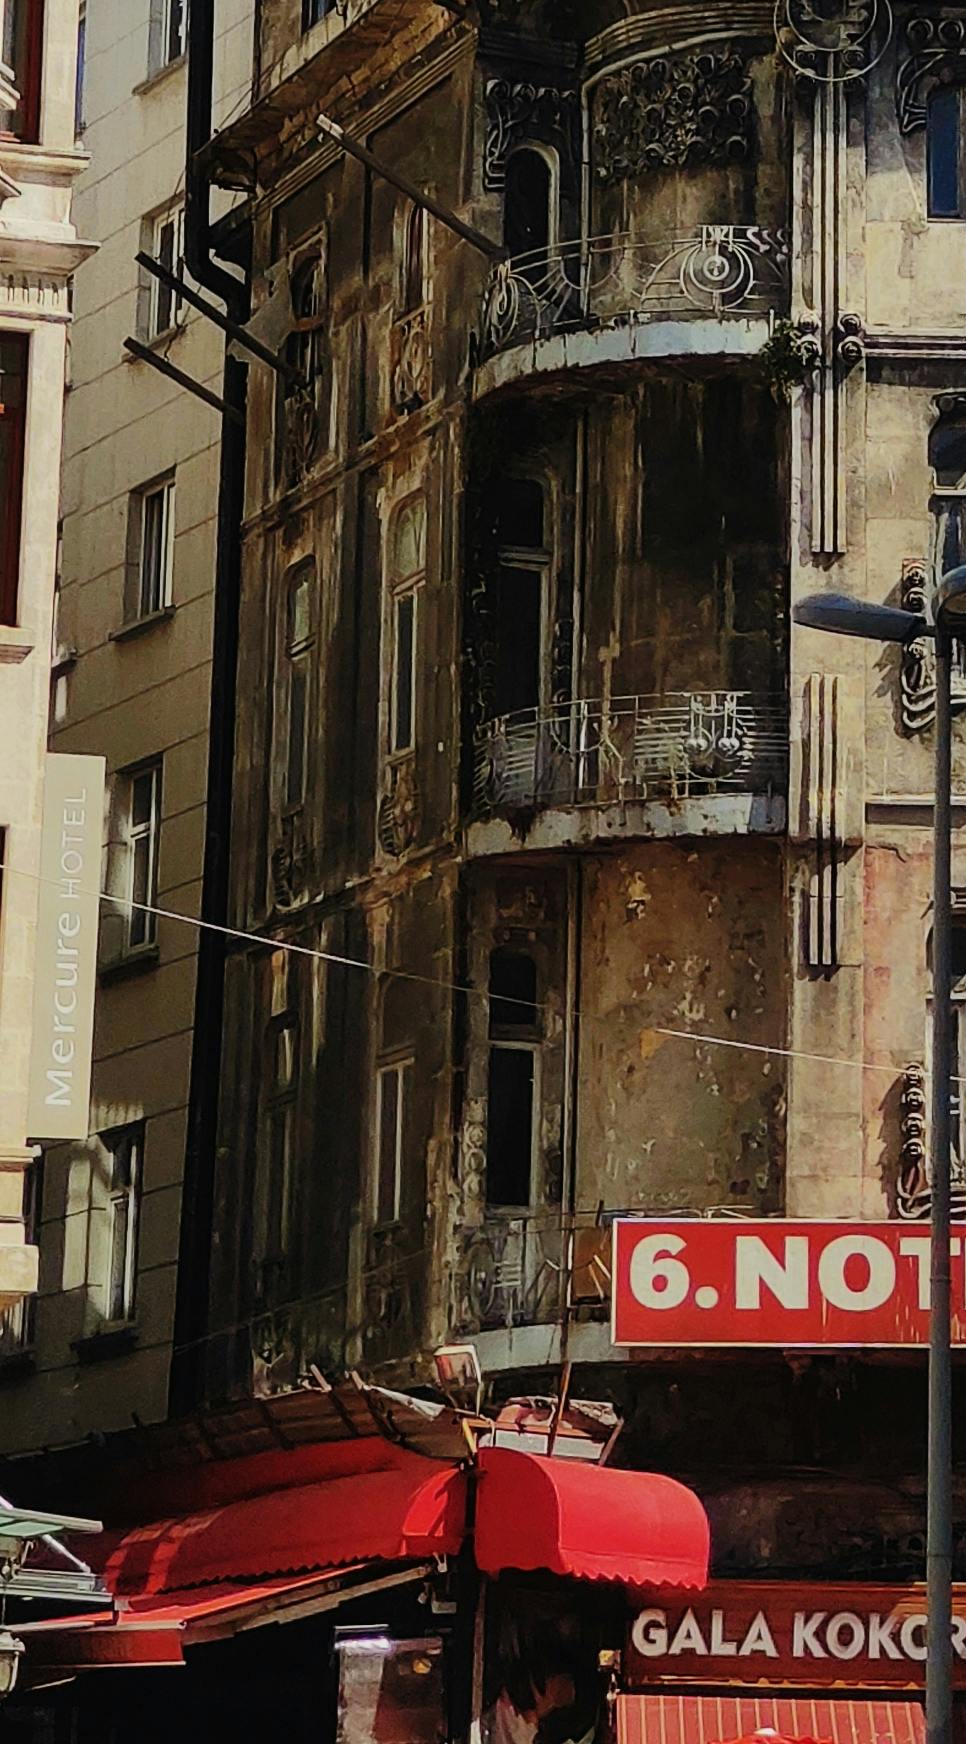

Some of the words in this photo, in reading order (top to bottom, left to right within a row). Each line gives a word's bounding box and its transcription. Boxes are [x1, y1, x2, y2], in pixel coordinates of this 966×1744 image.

[60, 787, 87, 899] HOTEL
[45, 912, 81, 1106] Mercure
[631, 1607, 779, 1658] GALA
